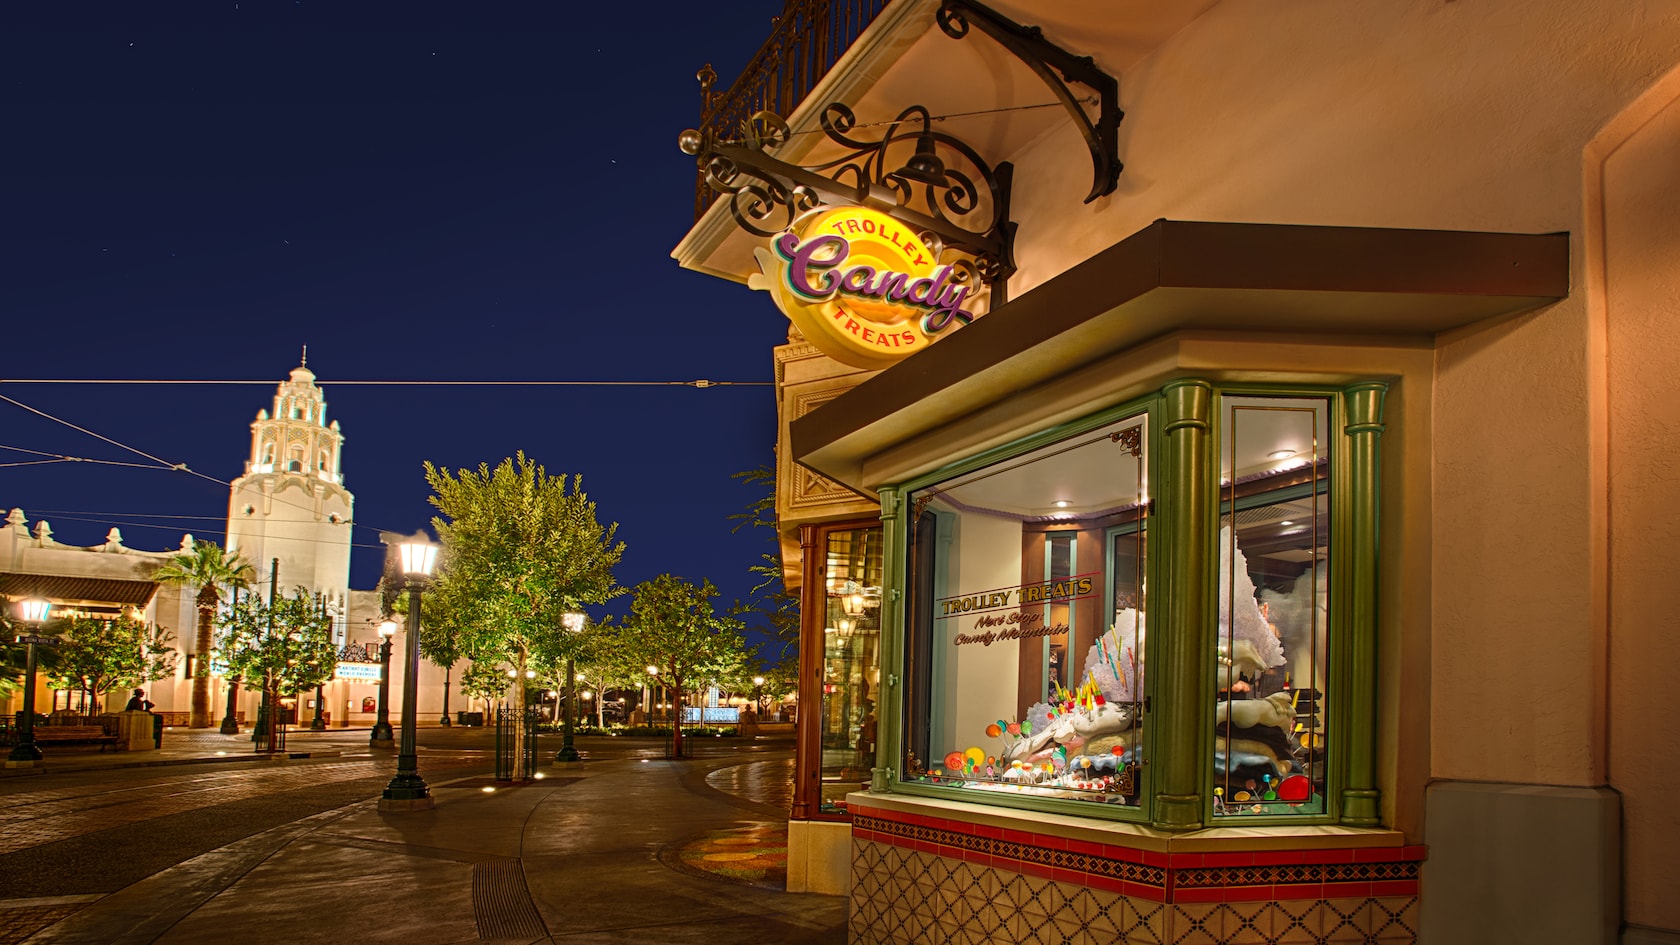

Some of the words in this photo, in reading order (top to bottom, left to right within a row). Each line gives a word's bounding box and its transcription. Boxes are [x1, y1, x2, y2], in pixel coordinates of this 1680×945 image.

[832, 219, 928, 266] TROLLEY
[777, 233, 973, 330] Candy
[833, 306, 916, 347] TREATS
[942, 590, 1012, 614] TROLLEY
[1016, 578, 1092, 603] TREATS
[953, 630, 997, 646] Candy
[996, 623, 1069, 642] Mountain
[974, 615, 1005, 629] Next
